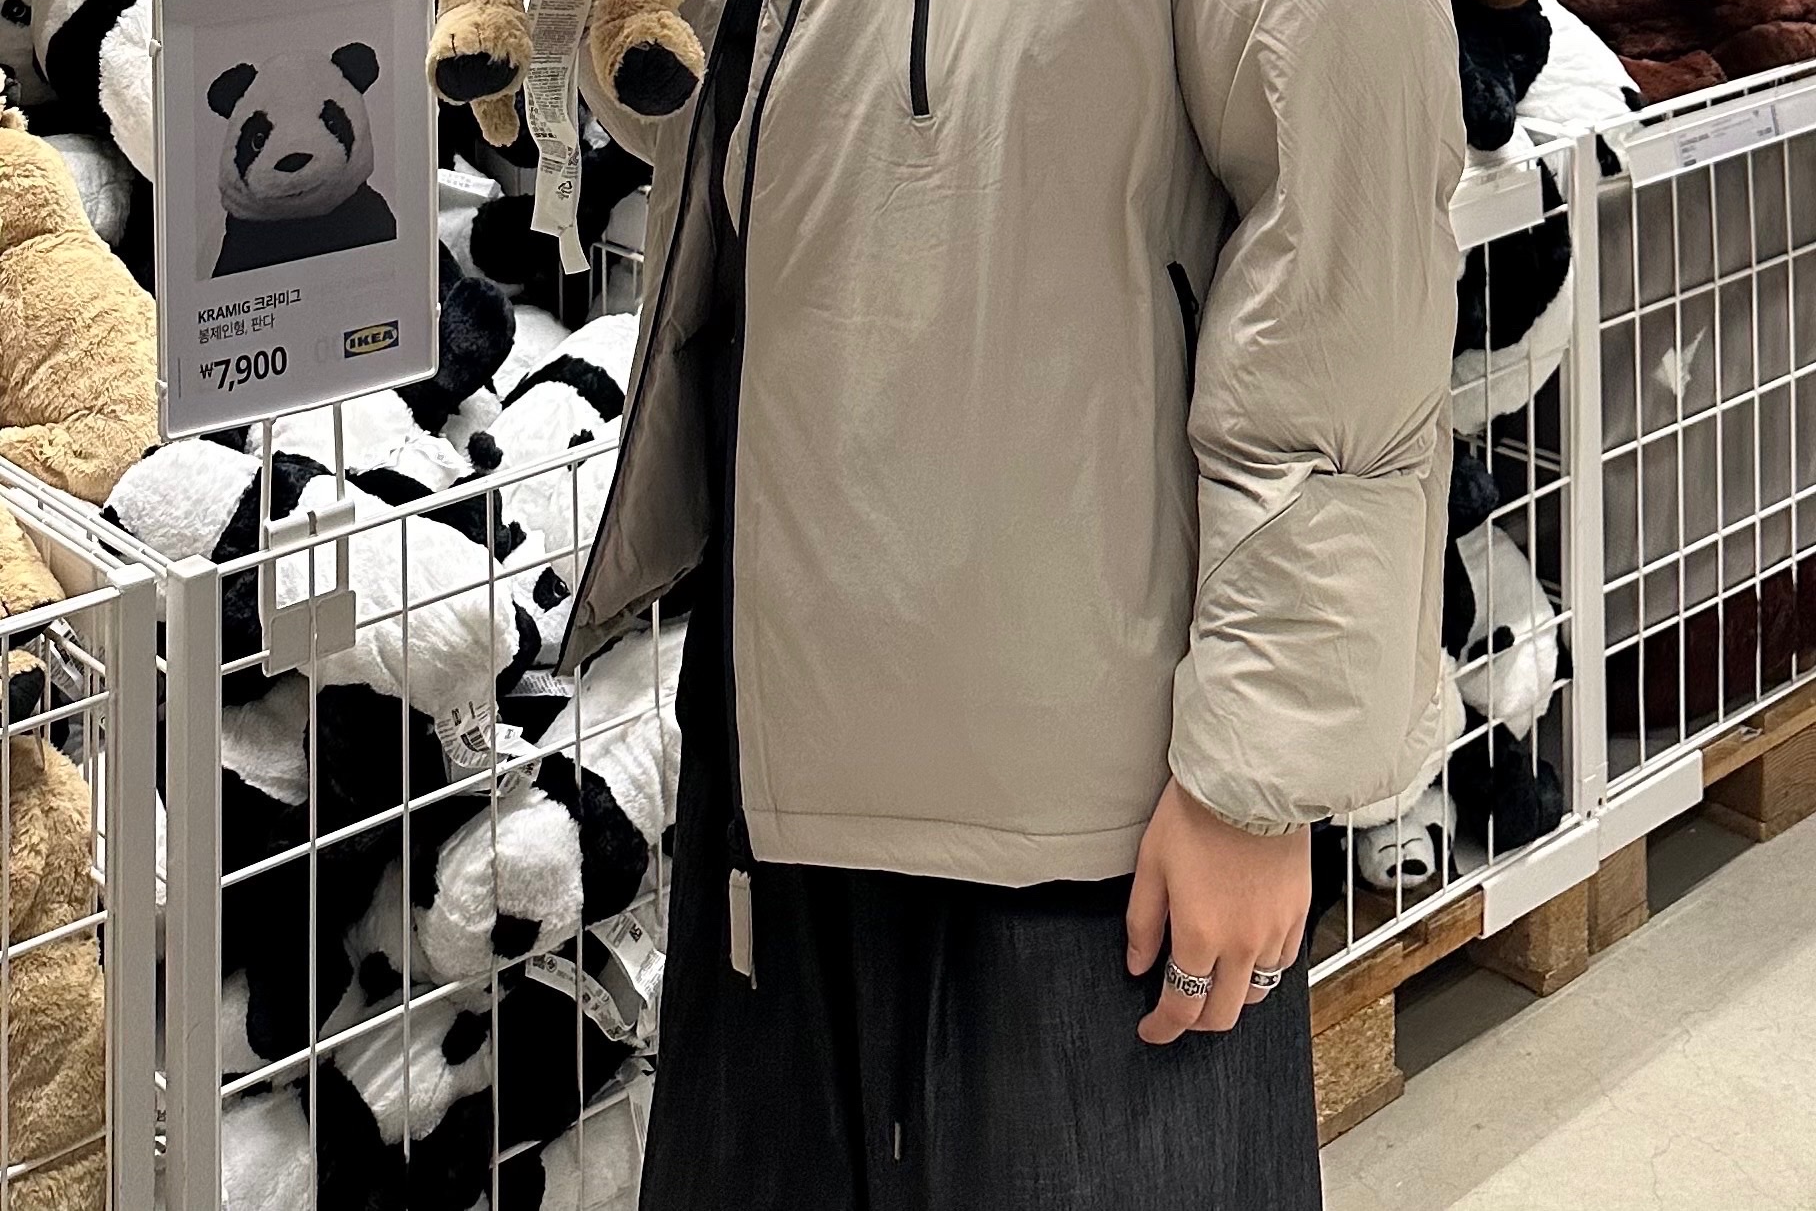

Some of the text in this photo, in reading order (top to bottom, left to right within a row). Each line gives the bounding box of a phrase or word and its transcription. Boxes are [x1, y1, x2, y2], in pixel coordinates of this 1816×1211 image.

[198, 289, 301, 324] KRAMIG 크라미그
[199, 313, 275, 344] 봉제인형, 판다
[349, 329, 395, 349] IKEA
[199, 346, 287, 392] ₩7,900
